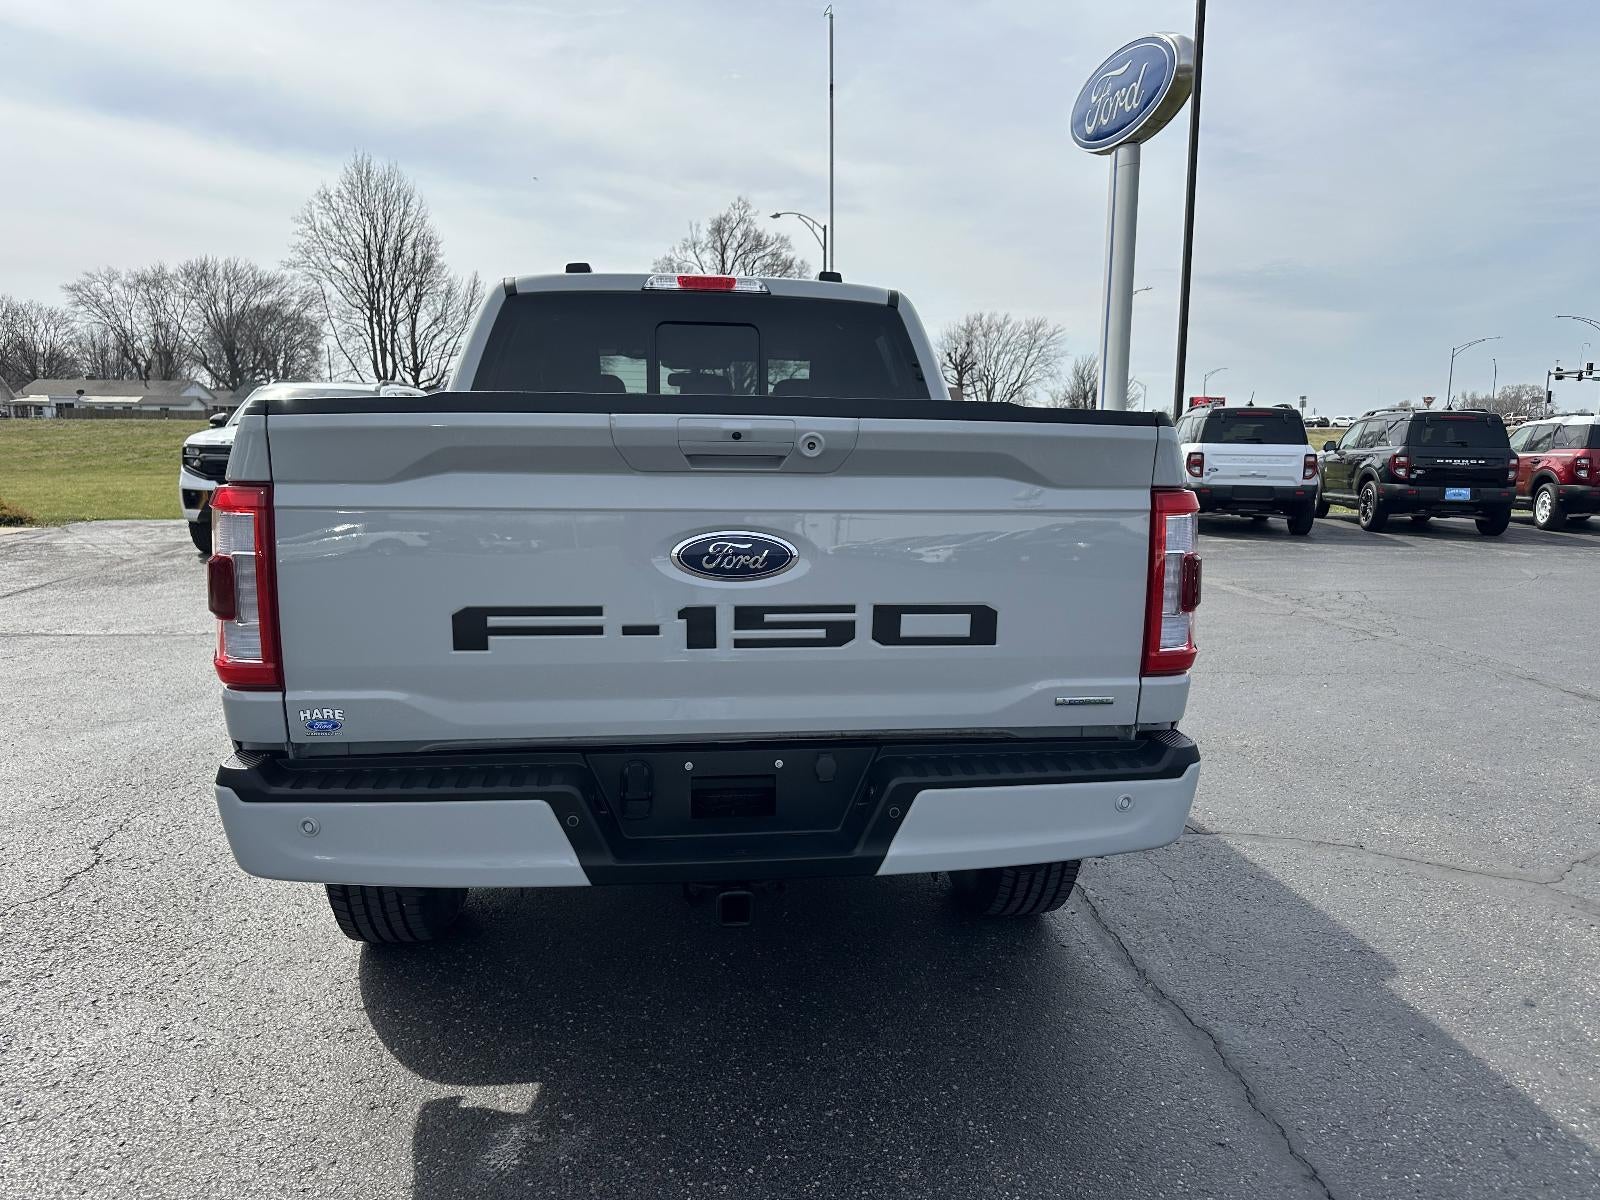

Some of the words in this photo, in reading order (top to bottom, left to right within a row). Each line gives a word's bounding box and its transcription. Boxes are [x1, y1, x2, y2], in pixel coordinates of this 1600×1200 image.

[1085, 60, 1149, 134] Ford
[701, 541, 770, 569] Ford
[451, 604, 998, 652] F-150
[299, 708, 345, 721] HARE
